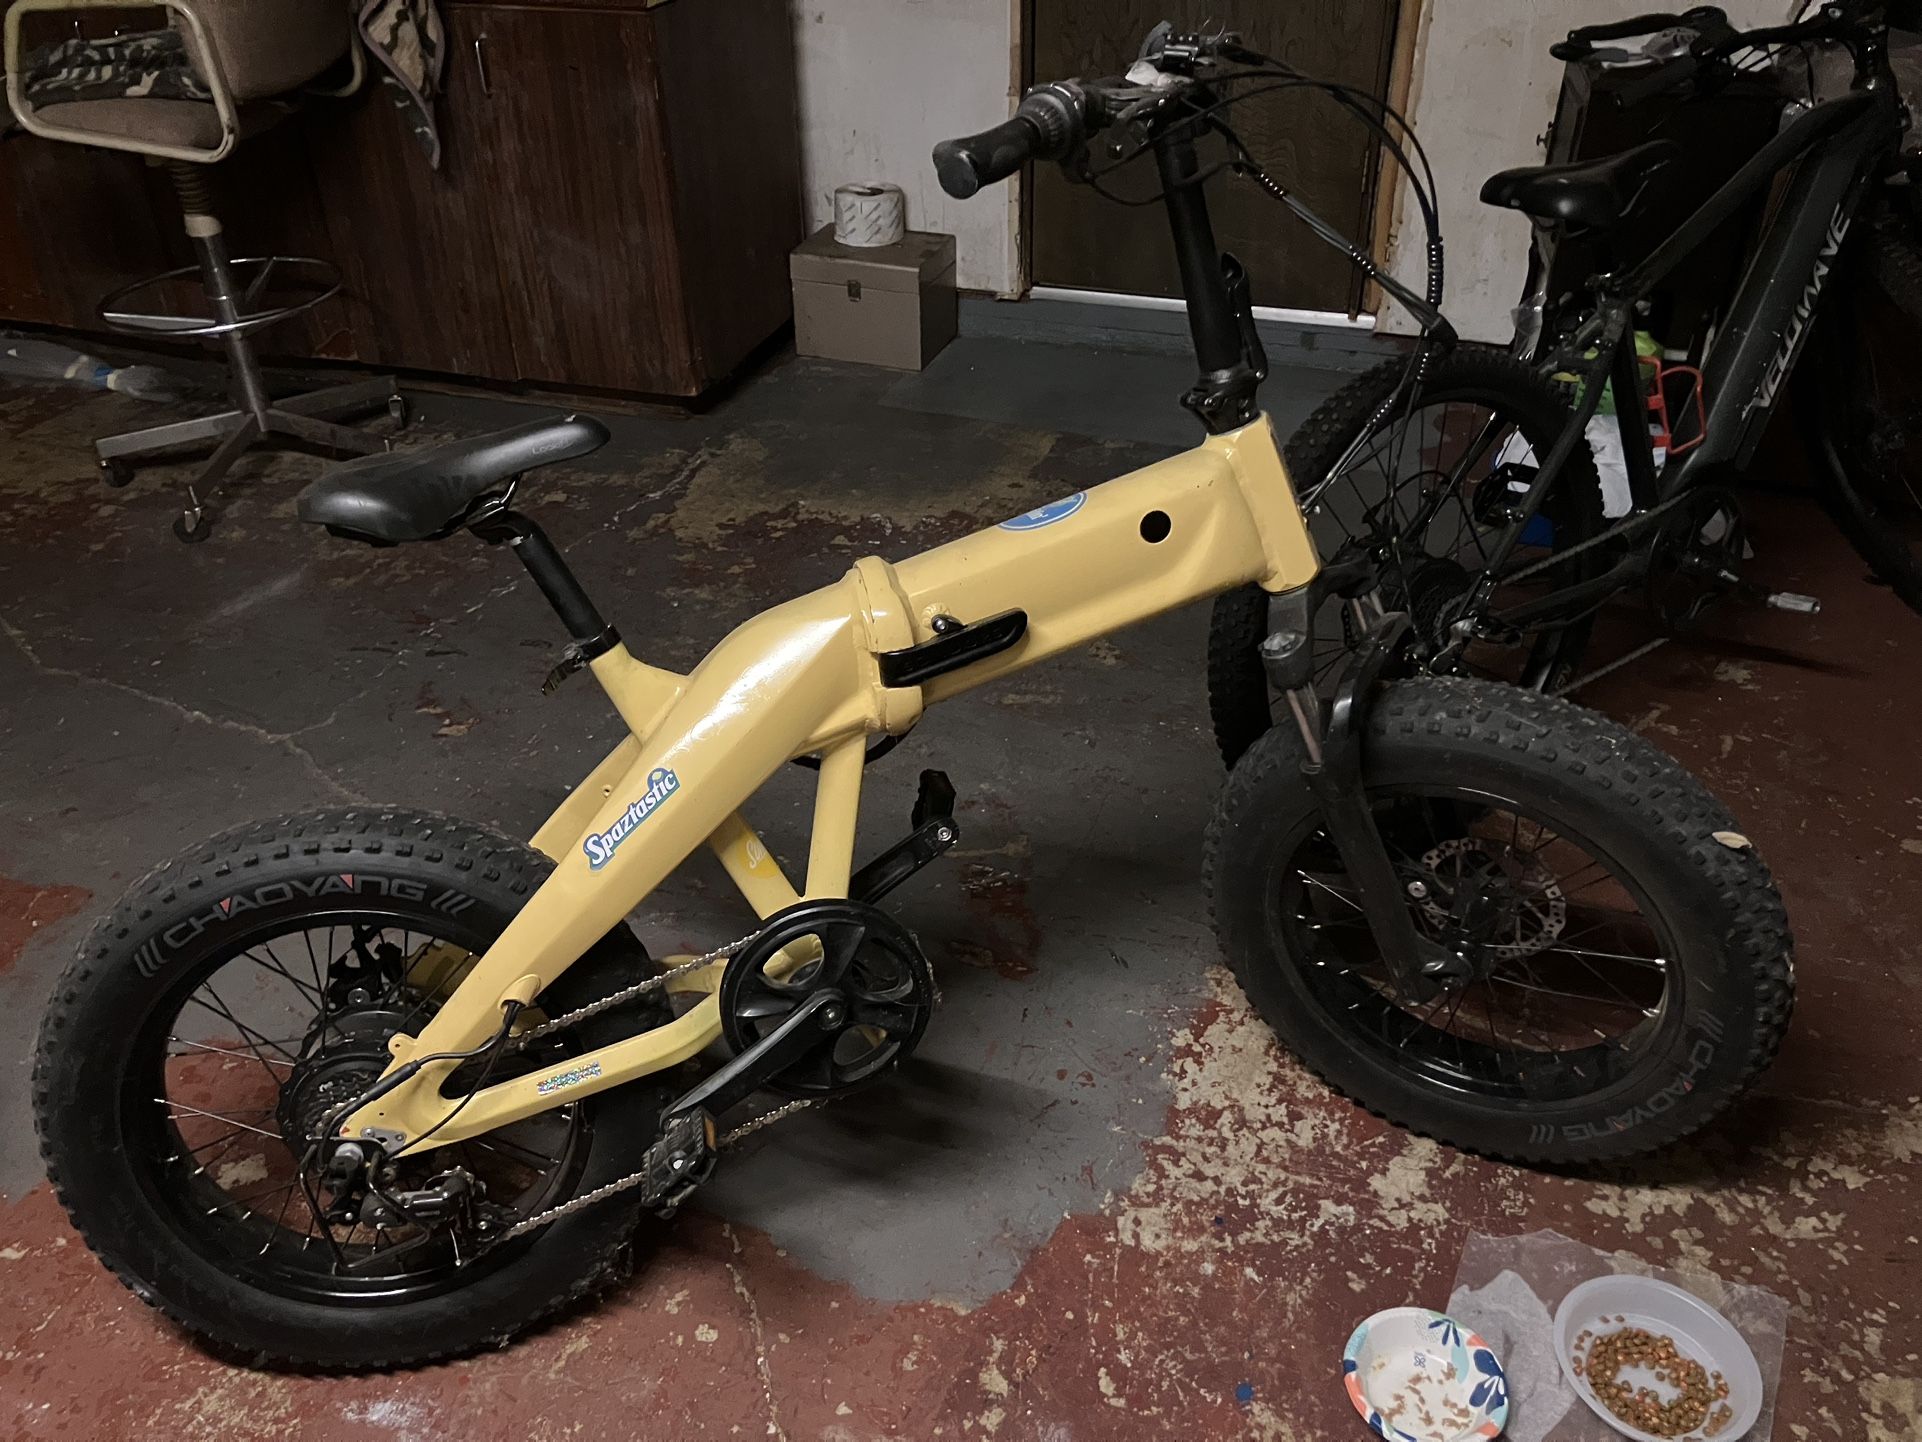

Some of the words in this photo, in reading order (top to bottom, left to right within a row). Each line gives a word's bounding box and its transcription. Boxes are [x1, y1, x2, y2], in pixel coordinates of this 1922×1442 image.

[1751, 202, 1851, 408] VELOWAVE
[585, 771, 677, 866] Spaztastic
[162, 873, 428, 950] CHAOYANG
[1563, 1039, 1715, 1141] CHAOYANG
